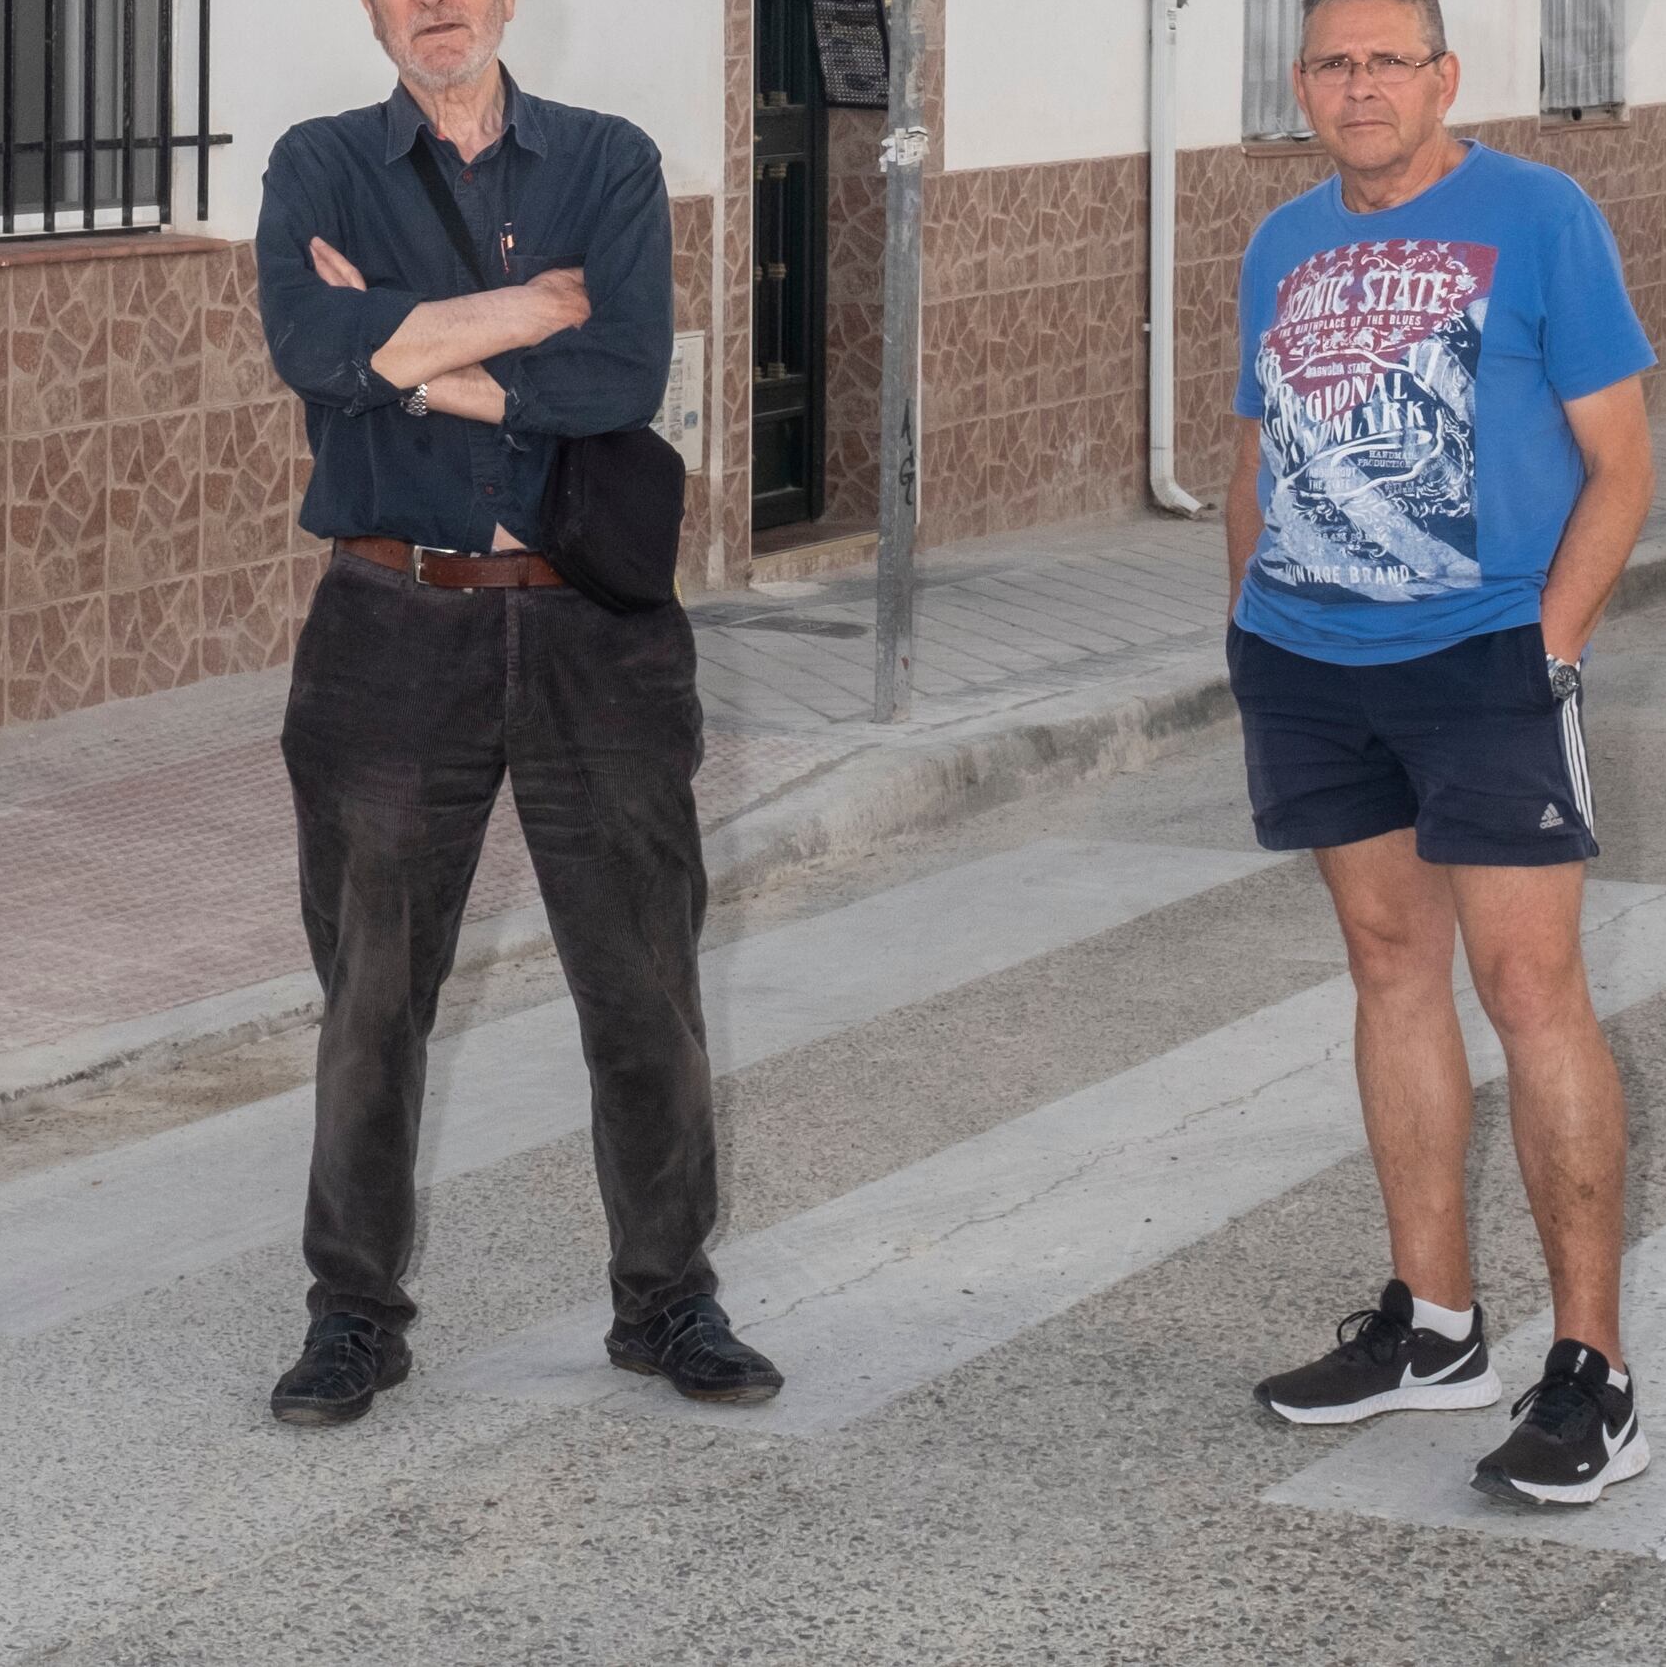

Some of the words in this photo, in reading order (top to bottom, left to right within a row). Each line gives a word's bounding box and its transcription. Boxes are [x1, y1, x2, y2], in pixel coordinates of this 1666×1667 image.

[1358, 270, 1452, 315] STATE
[1295, 318, 1345, 335] BIRTHPLACE
[1351, 316, 1362, 327] OF
[1367, 315, 1384, 326] THE
[1389, 315, 1422, 327] BLUES
[1284, 563, 1342, 584] VINTAGE
[1349, 564, 1410, 584] BRAND
